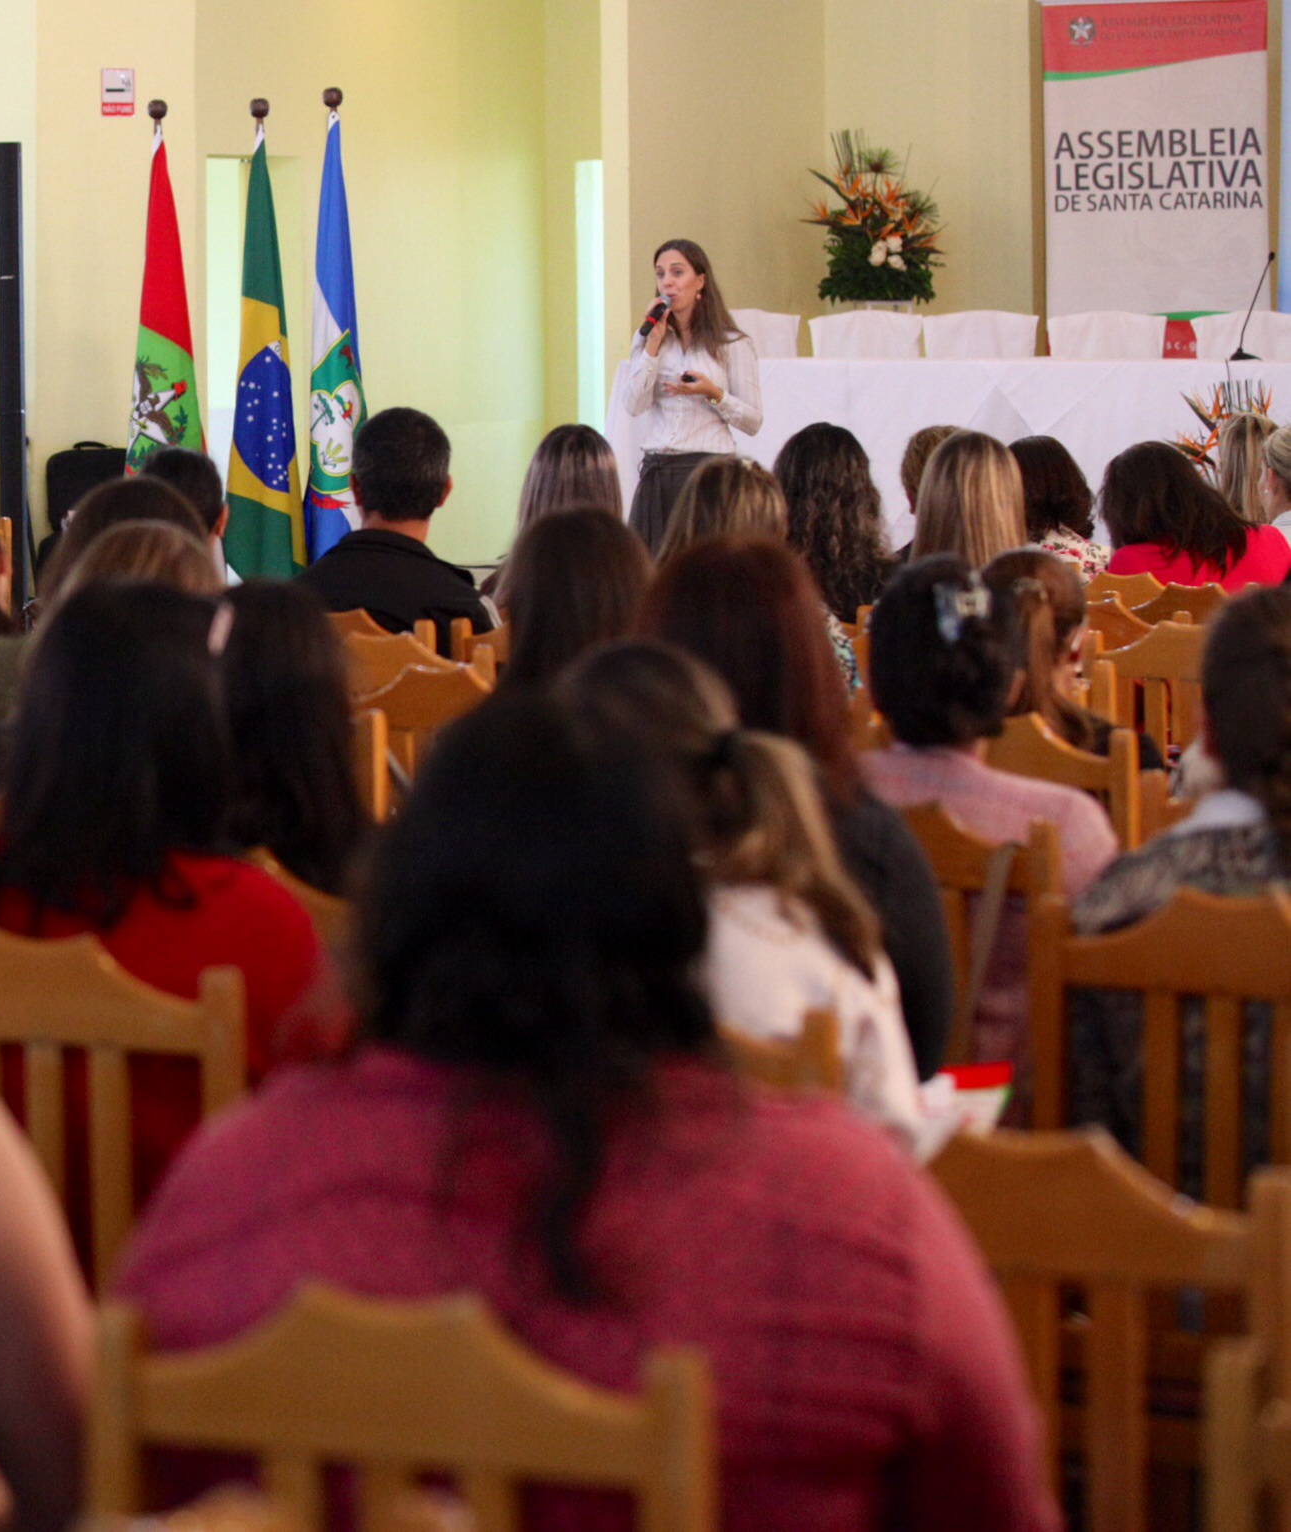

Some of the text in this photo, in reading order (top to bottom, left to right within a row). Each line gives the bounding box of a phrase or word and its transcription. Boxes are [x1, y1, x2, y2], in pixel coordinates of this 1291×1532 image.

[1054, 127, 1262, 160] ASSEMBLEIA
[1055, 159, 1262, 191] LEGISLATIVA
[1055, 190, 1263, 213] DE SANTA CATARINA
